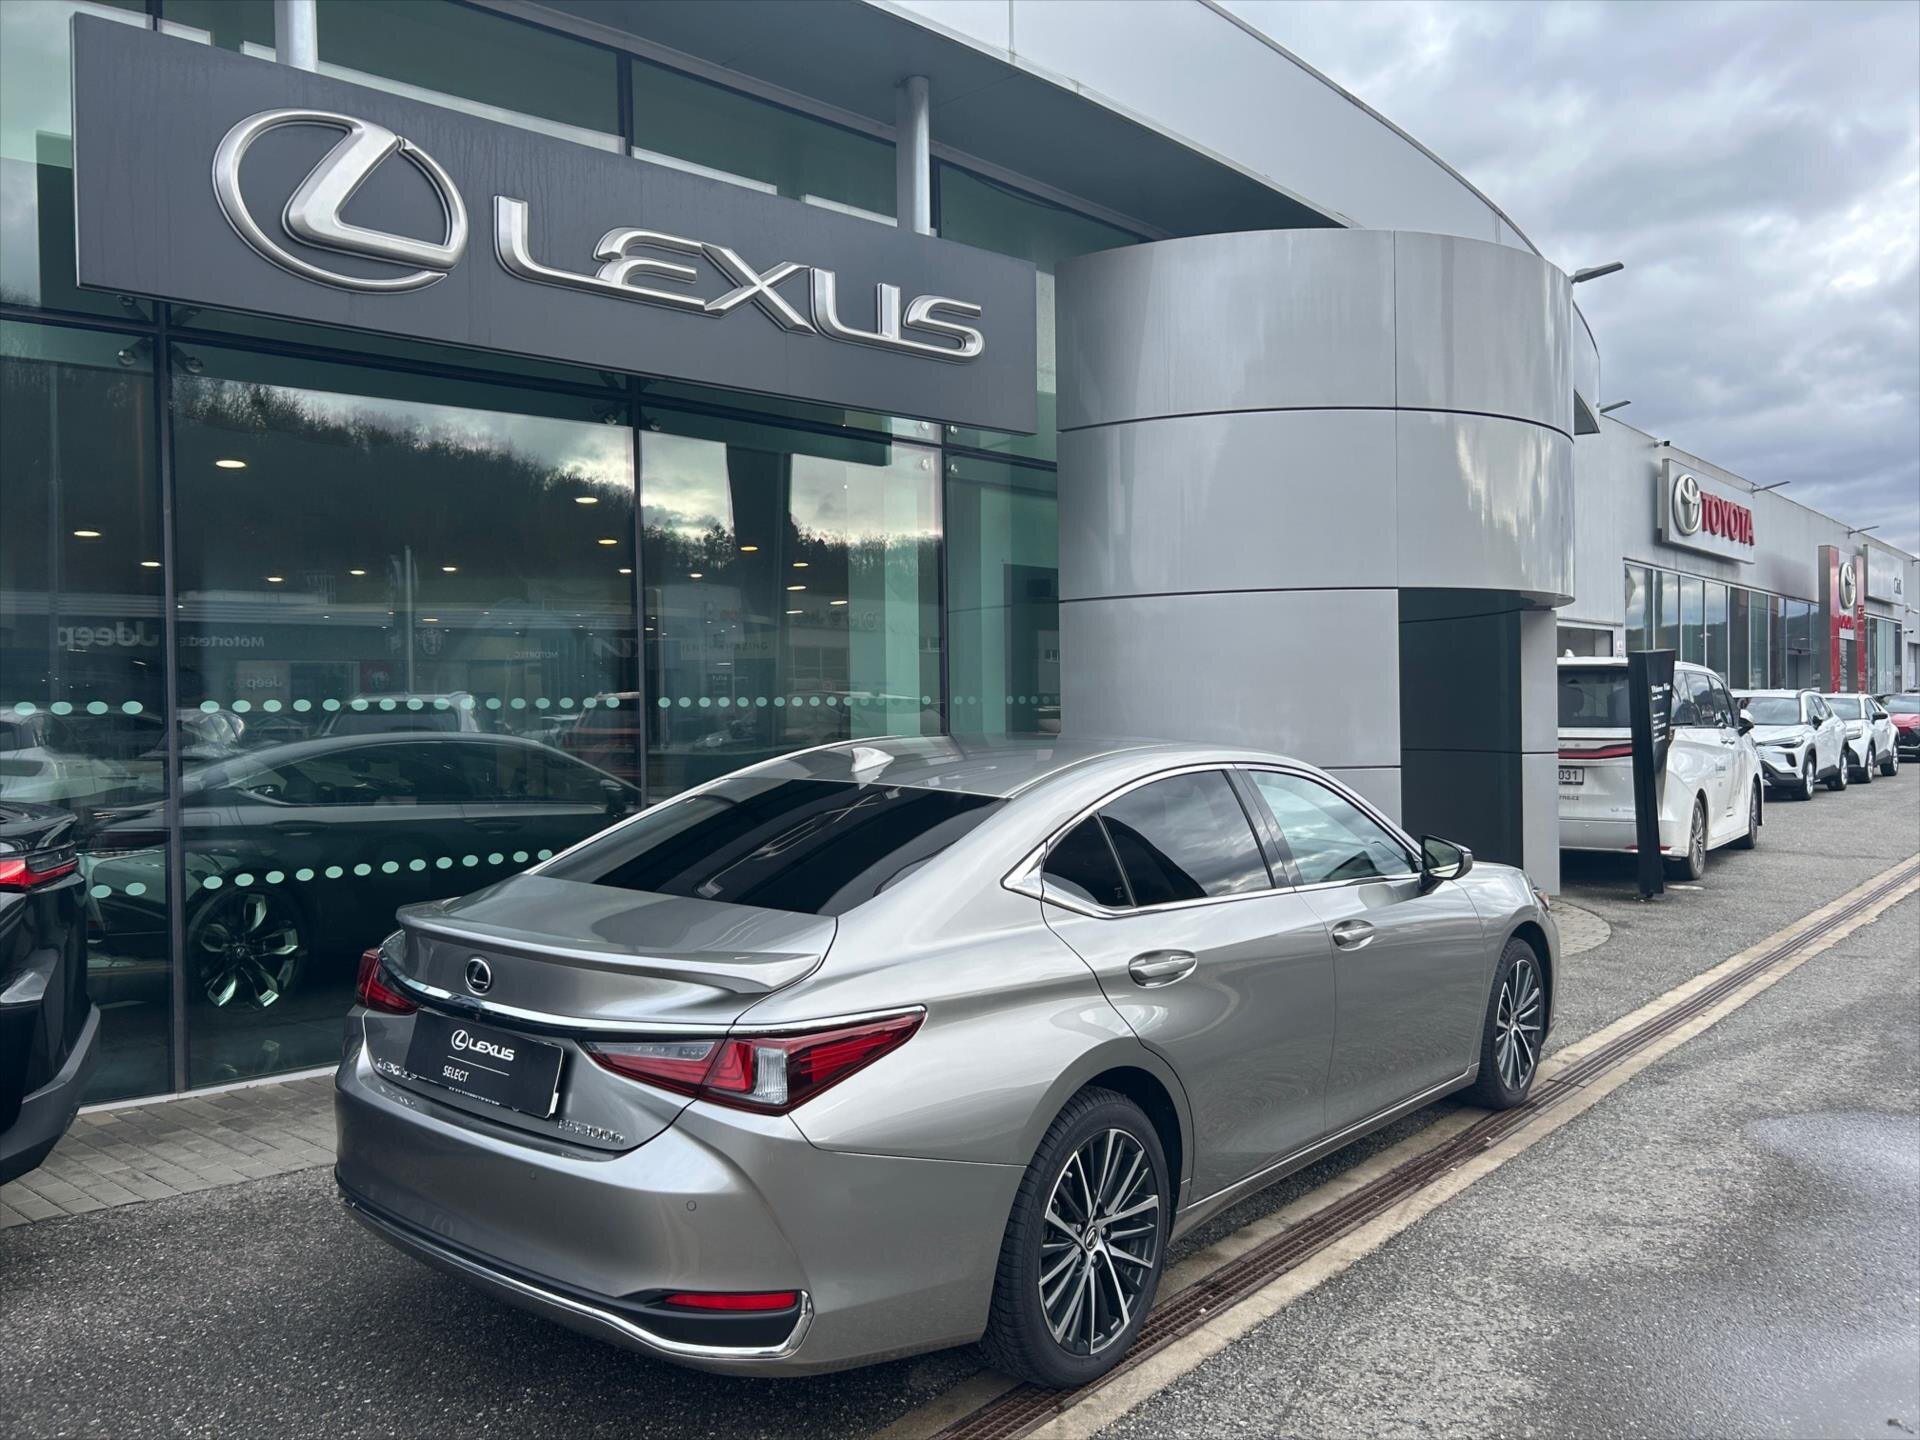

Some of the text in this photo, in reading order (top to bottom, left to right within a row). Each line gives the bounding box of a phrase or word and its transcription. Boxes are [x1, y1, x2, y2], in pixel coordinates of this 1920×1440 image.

[493, 194, 985, 363] LEXUS
[1700, 490, 1755, 547] TOYOTA
[468, 1037, 515, 1062] LEXUS
[442, 1065, 469, 1083] SELECT
